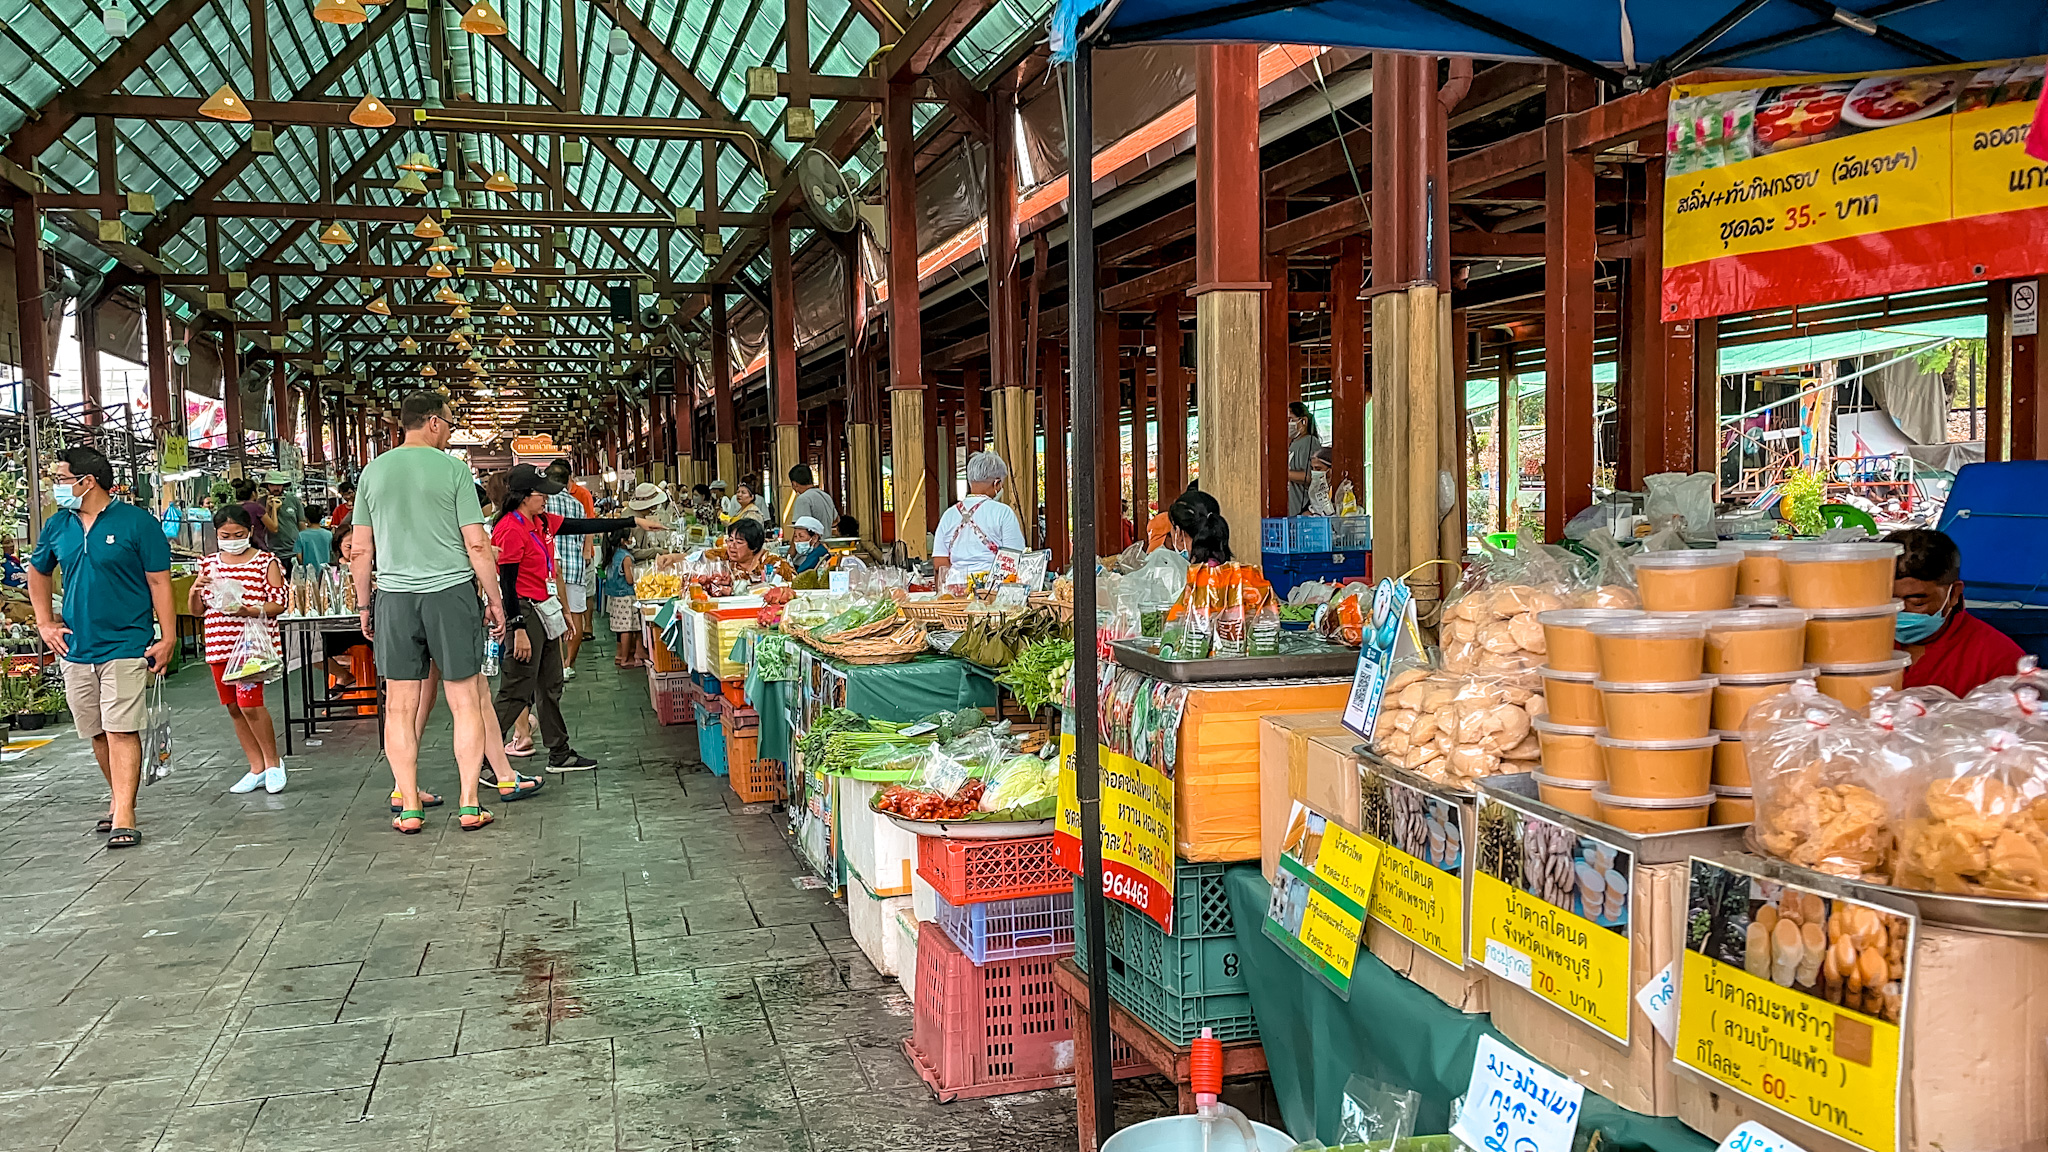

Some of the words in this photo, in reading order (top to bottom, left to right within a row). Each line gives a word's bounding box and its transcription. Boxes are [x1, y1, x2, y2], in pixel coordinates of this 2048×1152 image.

[1720, 216, 1775, 249] ชุดละ
[1783, 204, 1827, 232] 35.-
[1835, 193, 1879, 220] บาท
[1118, 803, 1142, 828] หวาน
[1353, 883, 1366, 899] บาท
[1382, 843, 1434, 892] น้ำตาลโตนด
[1506, 887, 1588, 949] น้ำตาลโตนด
[1337, 953, 1349, 971] บาท
[1503, 919, 1590, 982] จังหวัดเพชรบุรี
[1537, 970, 1562, 996] 70.-
[1704, 958, 1833, 1042] น้ำตาลมะพร้าว
[1724, 1018, 1828, 1078] สวนบ้านแพ้ว
[1762, 1073, 1797, 1104] 60.-
